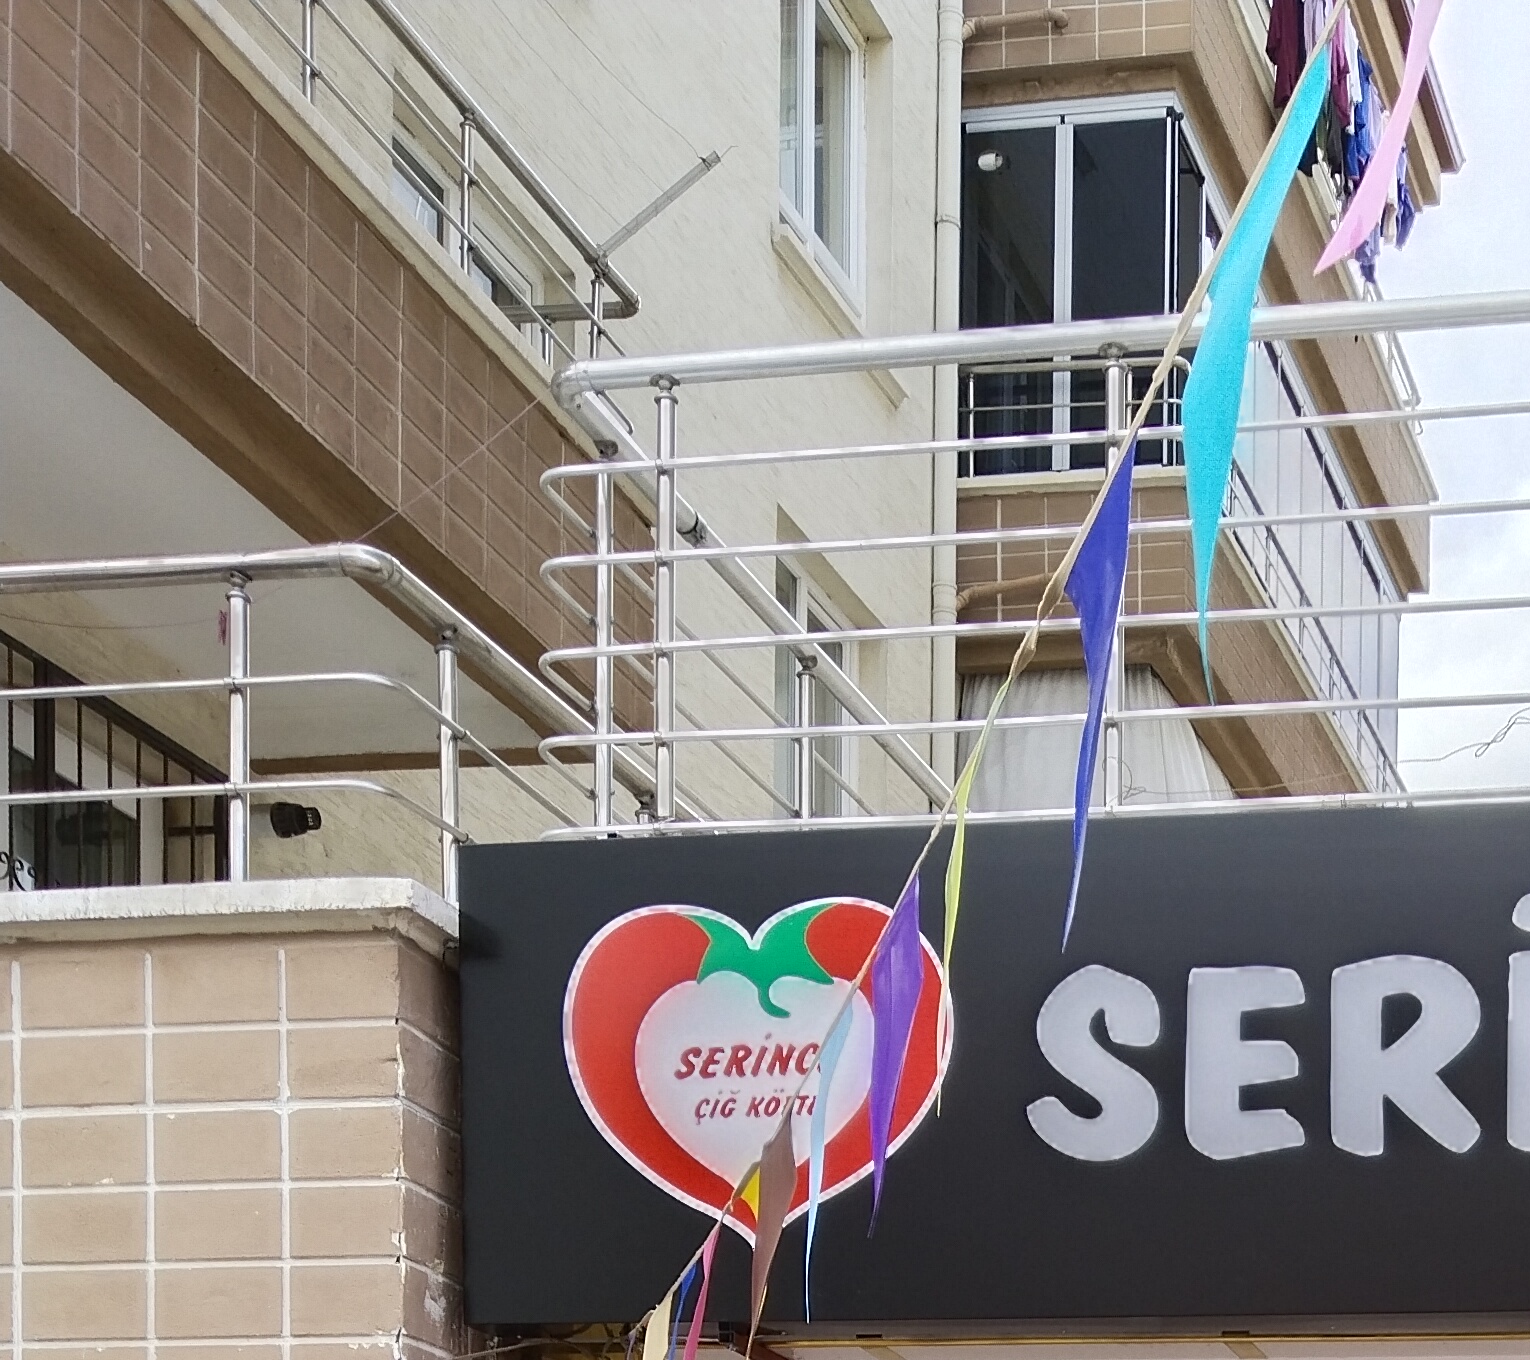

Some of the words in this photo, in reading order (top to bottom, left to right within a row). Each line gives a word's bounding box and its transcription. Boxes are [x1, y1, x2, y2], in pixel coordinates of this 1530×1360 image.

[673, 1032, 822, 1081] SERİNC
[694, 1088, 741, 1126] ÇİĞ
[745, 1088, 817, 1119] KÖT
